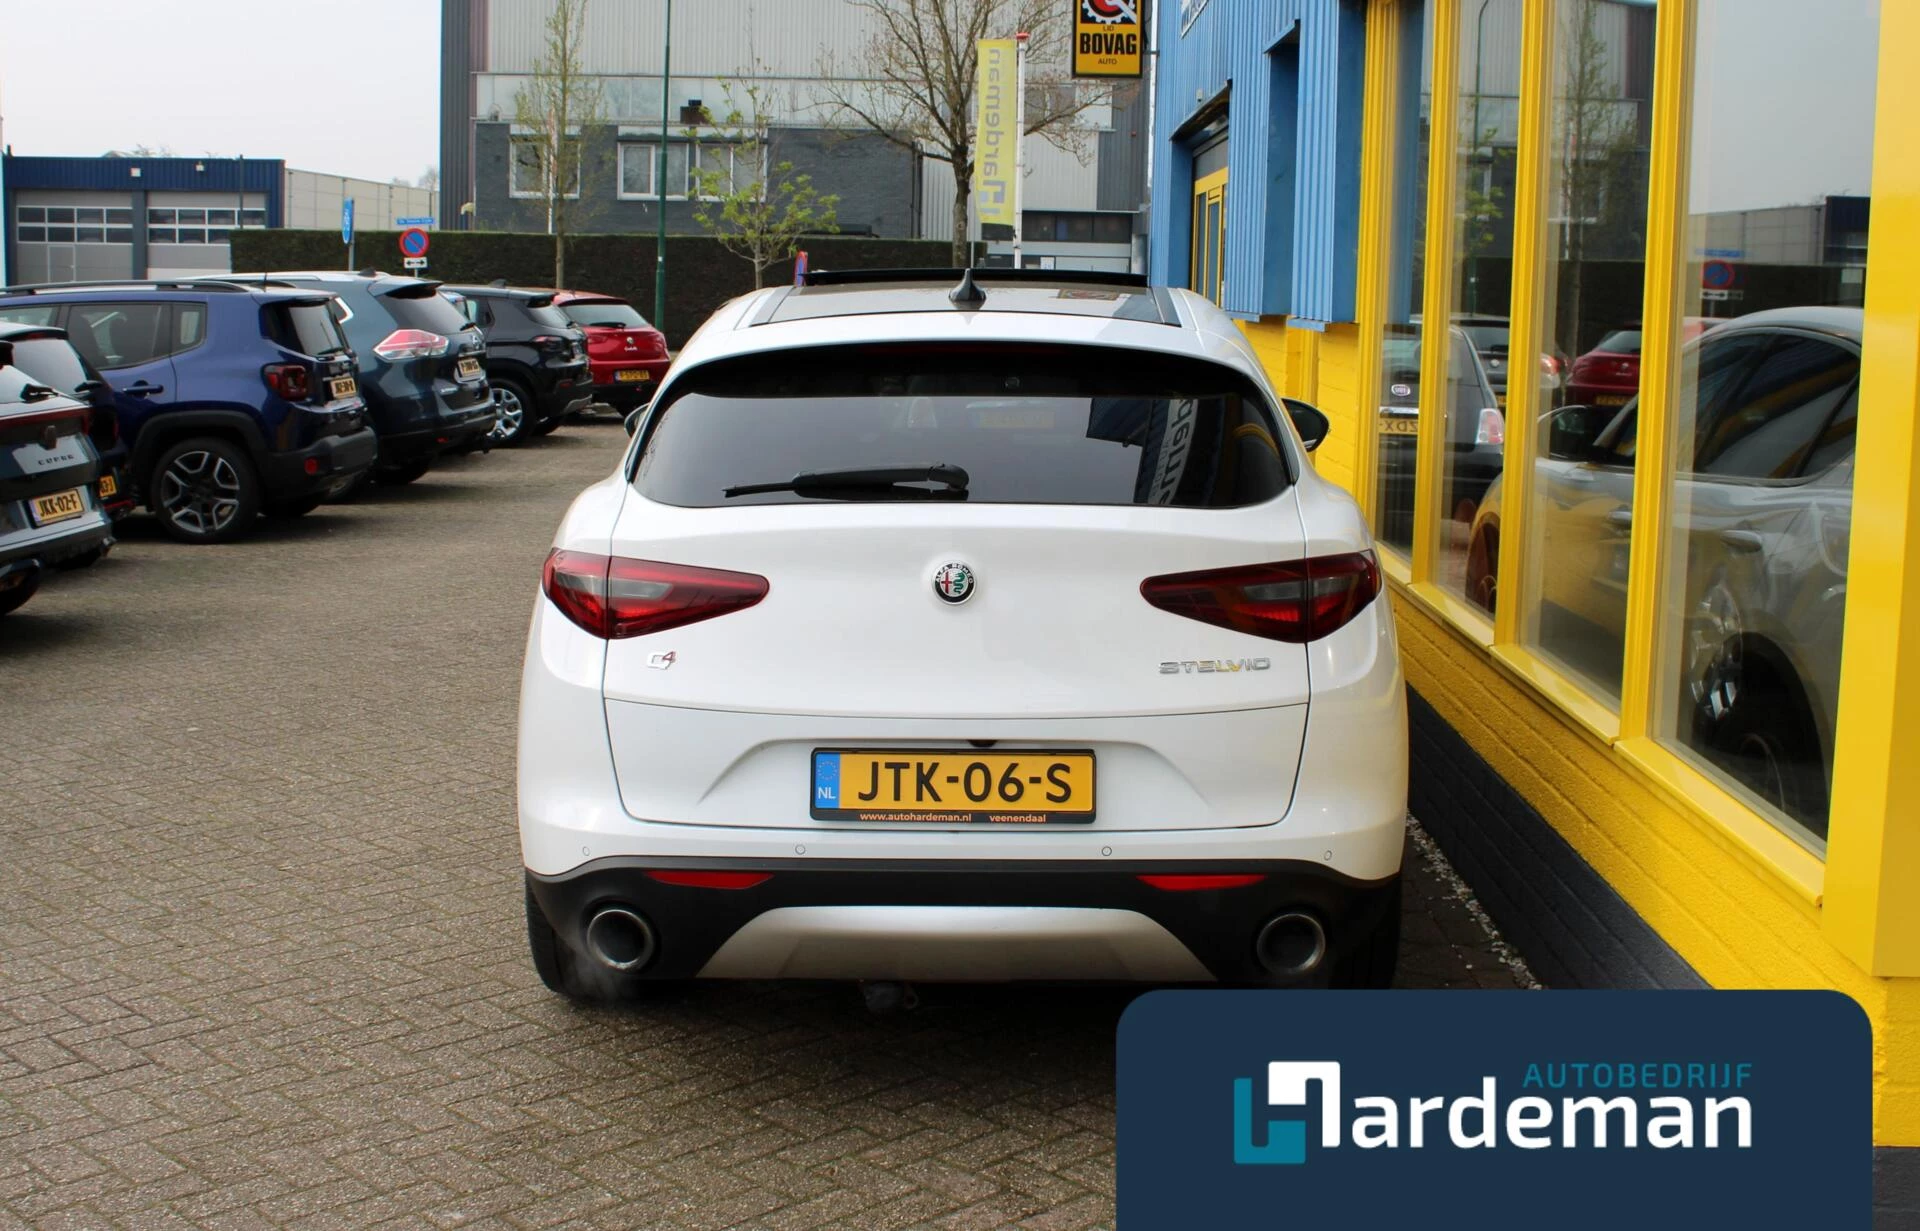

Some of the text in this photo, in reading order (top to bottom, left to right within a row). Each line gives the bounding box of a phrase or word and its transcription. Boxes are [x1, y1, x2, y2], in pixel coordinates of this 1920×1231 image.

[1080, 33, 1137, 55] BOVAG
[40, 494, 78, 517] JKK-02-F
[1159, 658, 1271, 674] STELVIO
[858, 761, 1072, 803] JTK-06-S
[818, 787, 836, 799] NL
[860, 812, 1046, 824] www.autohardeman.nl veenendaal
